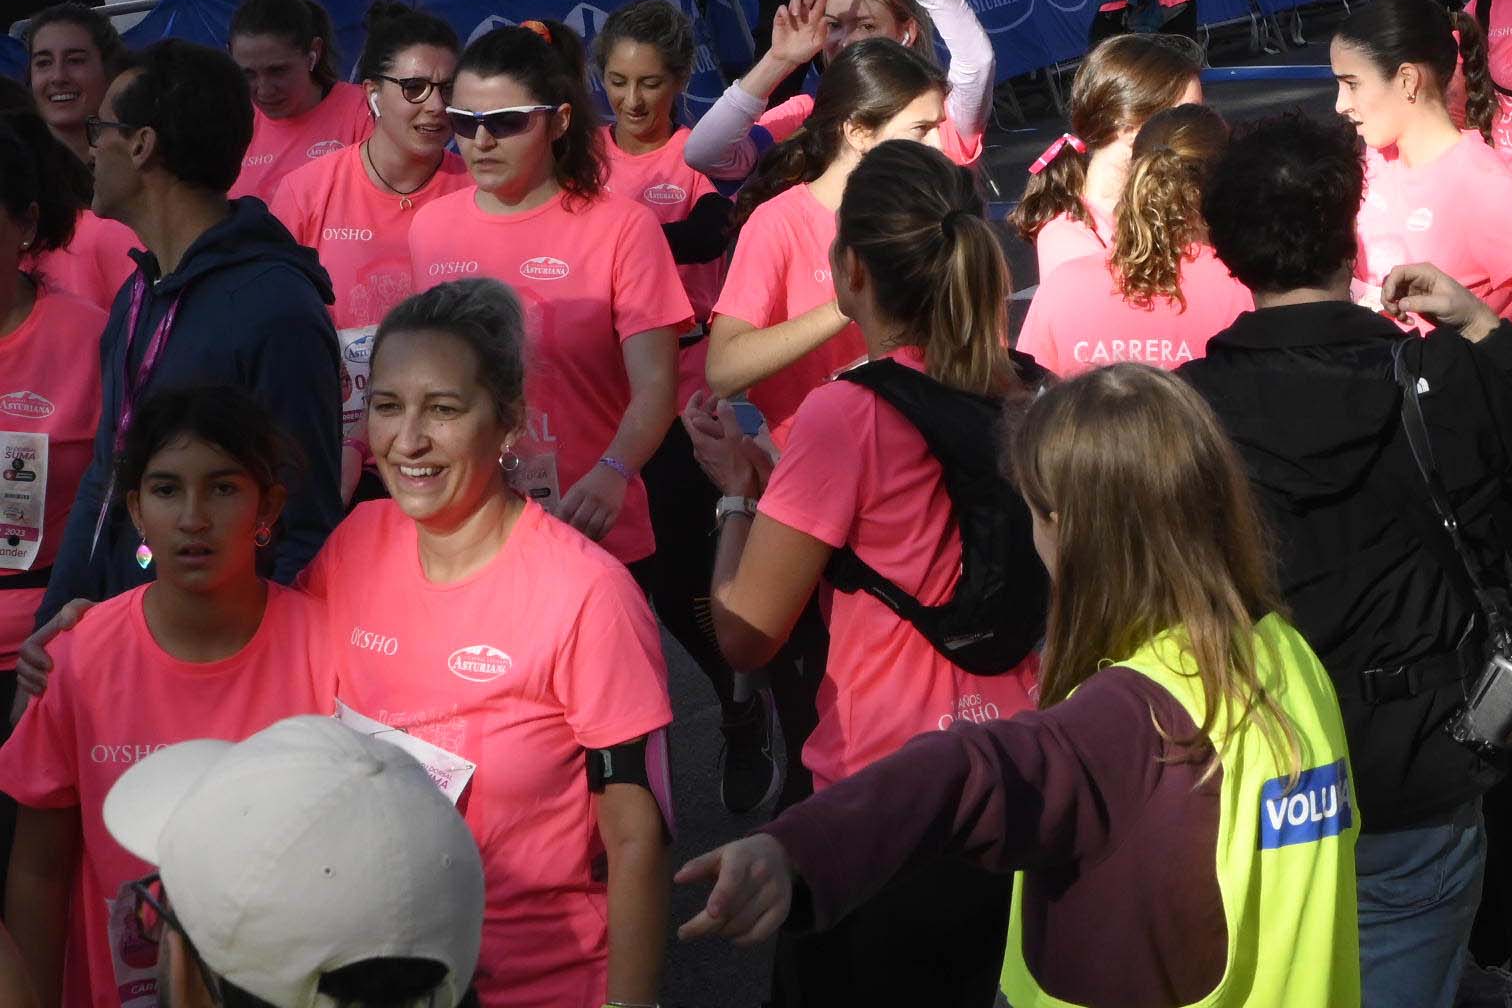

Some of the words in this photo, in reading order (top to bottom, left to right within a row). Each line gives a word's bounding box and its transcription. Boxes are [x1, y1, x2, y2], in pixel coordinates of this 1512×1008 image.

[323, 228, 372, 241] OYSHO
[429, 261, 478, 276] OYSHO
[523, 265, 567, 276] ASTURIANA
[1072, 339, 1193, 363] CARRERA
[0, 400, 50, 414] ASTURIANA
[4, 452, 36, 460] SUMA
[0, 548, 28, 558] ander
[351, 626, 398, 655] OYSHO
[958, 694, 981, 708] AÑOS
